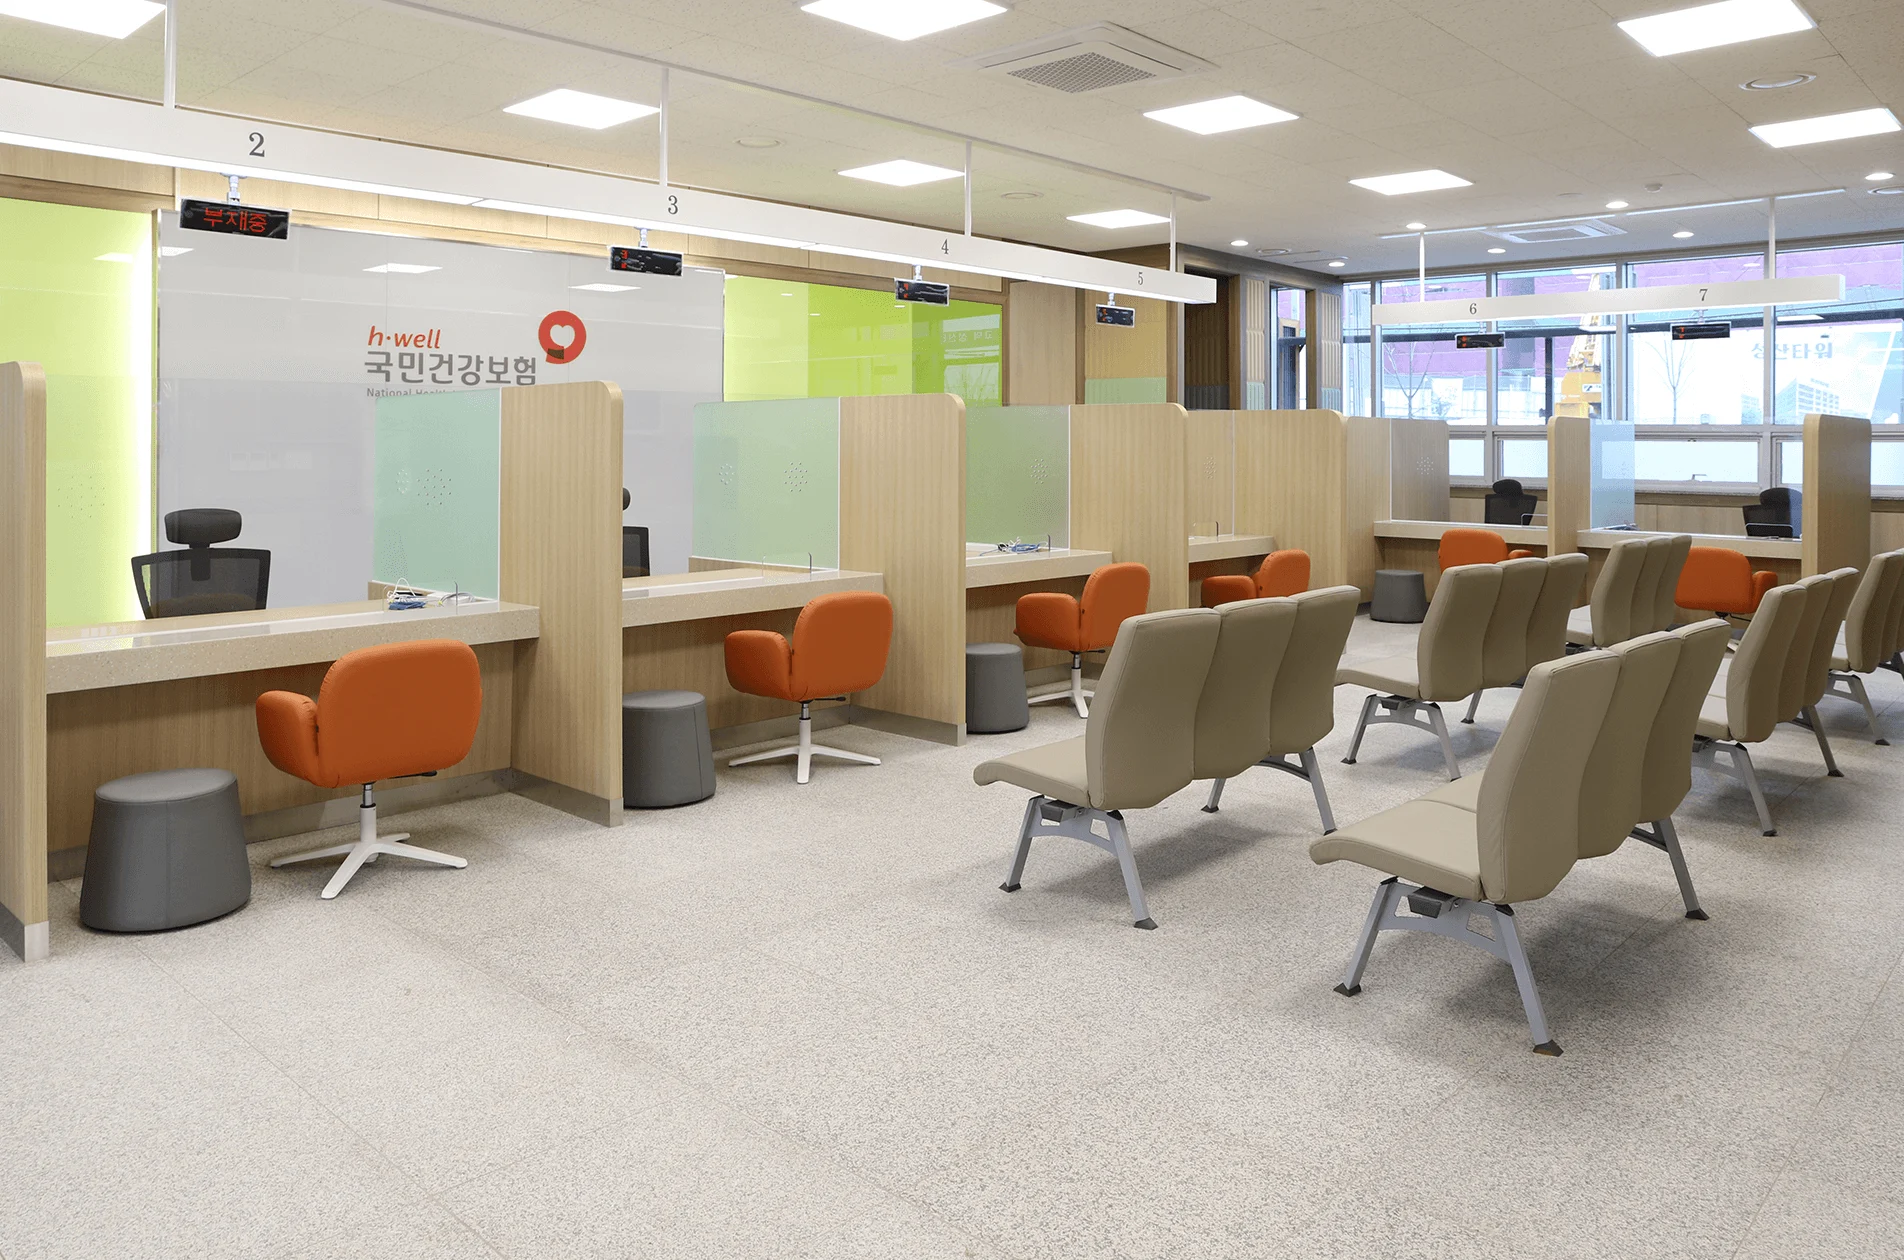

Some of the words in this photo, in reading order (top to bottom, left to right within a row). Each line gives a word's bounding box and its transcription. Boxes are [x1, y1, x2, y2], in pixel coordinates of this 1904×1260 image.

[249, 131, 265, 157] 2
[667, 195, 679, 215] 3
[203, 207, 267, 232] 부재중
[941, 238, 949, 255] 4
[1137, 271, 1144, 286] 5
[1699, 288, 1708, 301] 7
[1469, 302, 1477, 315] 6
[364, 350, 536, 386] 국민건강보험
